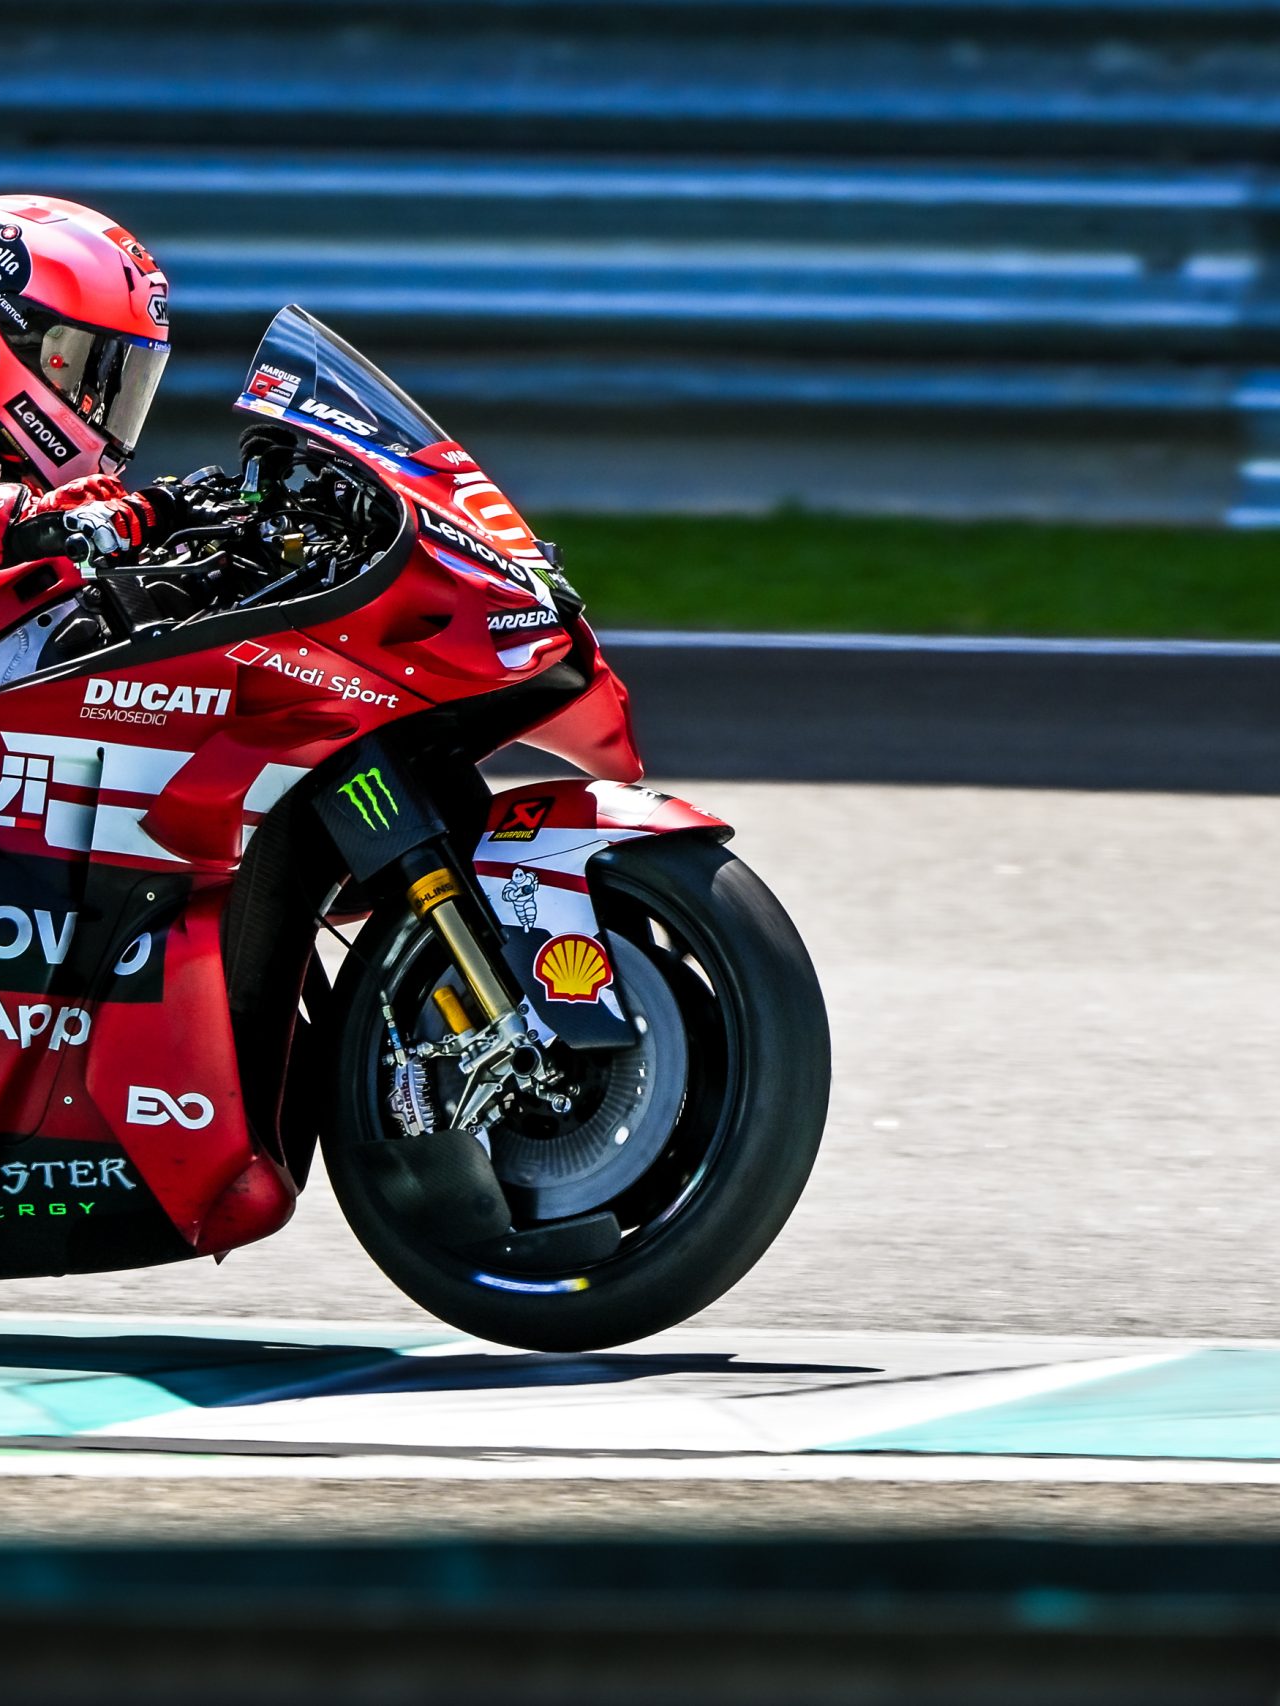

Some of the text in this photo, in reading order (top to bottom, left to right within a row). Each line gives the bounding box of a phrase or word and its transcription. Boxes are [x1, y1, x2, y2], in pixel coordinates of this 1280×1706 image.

[260, 363, 302, 385] MARQUEZ
[270, 386, 291, 398] Lenovo
[13, 400, 67, 457] Lenovo
[299, 398, 379, 436] WRS
[420, 508, 527, 582] Lenovo
[486, 610, 558, 630] ARRERA
[83, 678, 232, 715] DUCATI
[263, 653, 399, 709] Audi Sport
[79, 706, 167, 726] DESMOSEDICI
[401, 1073, 417, 1125] brembo
